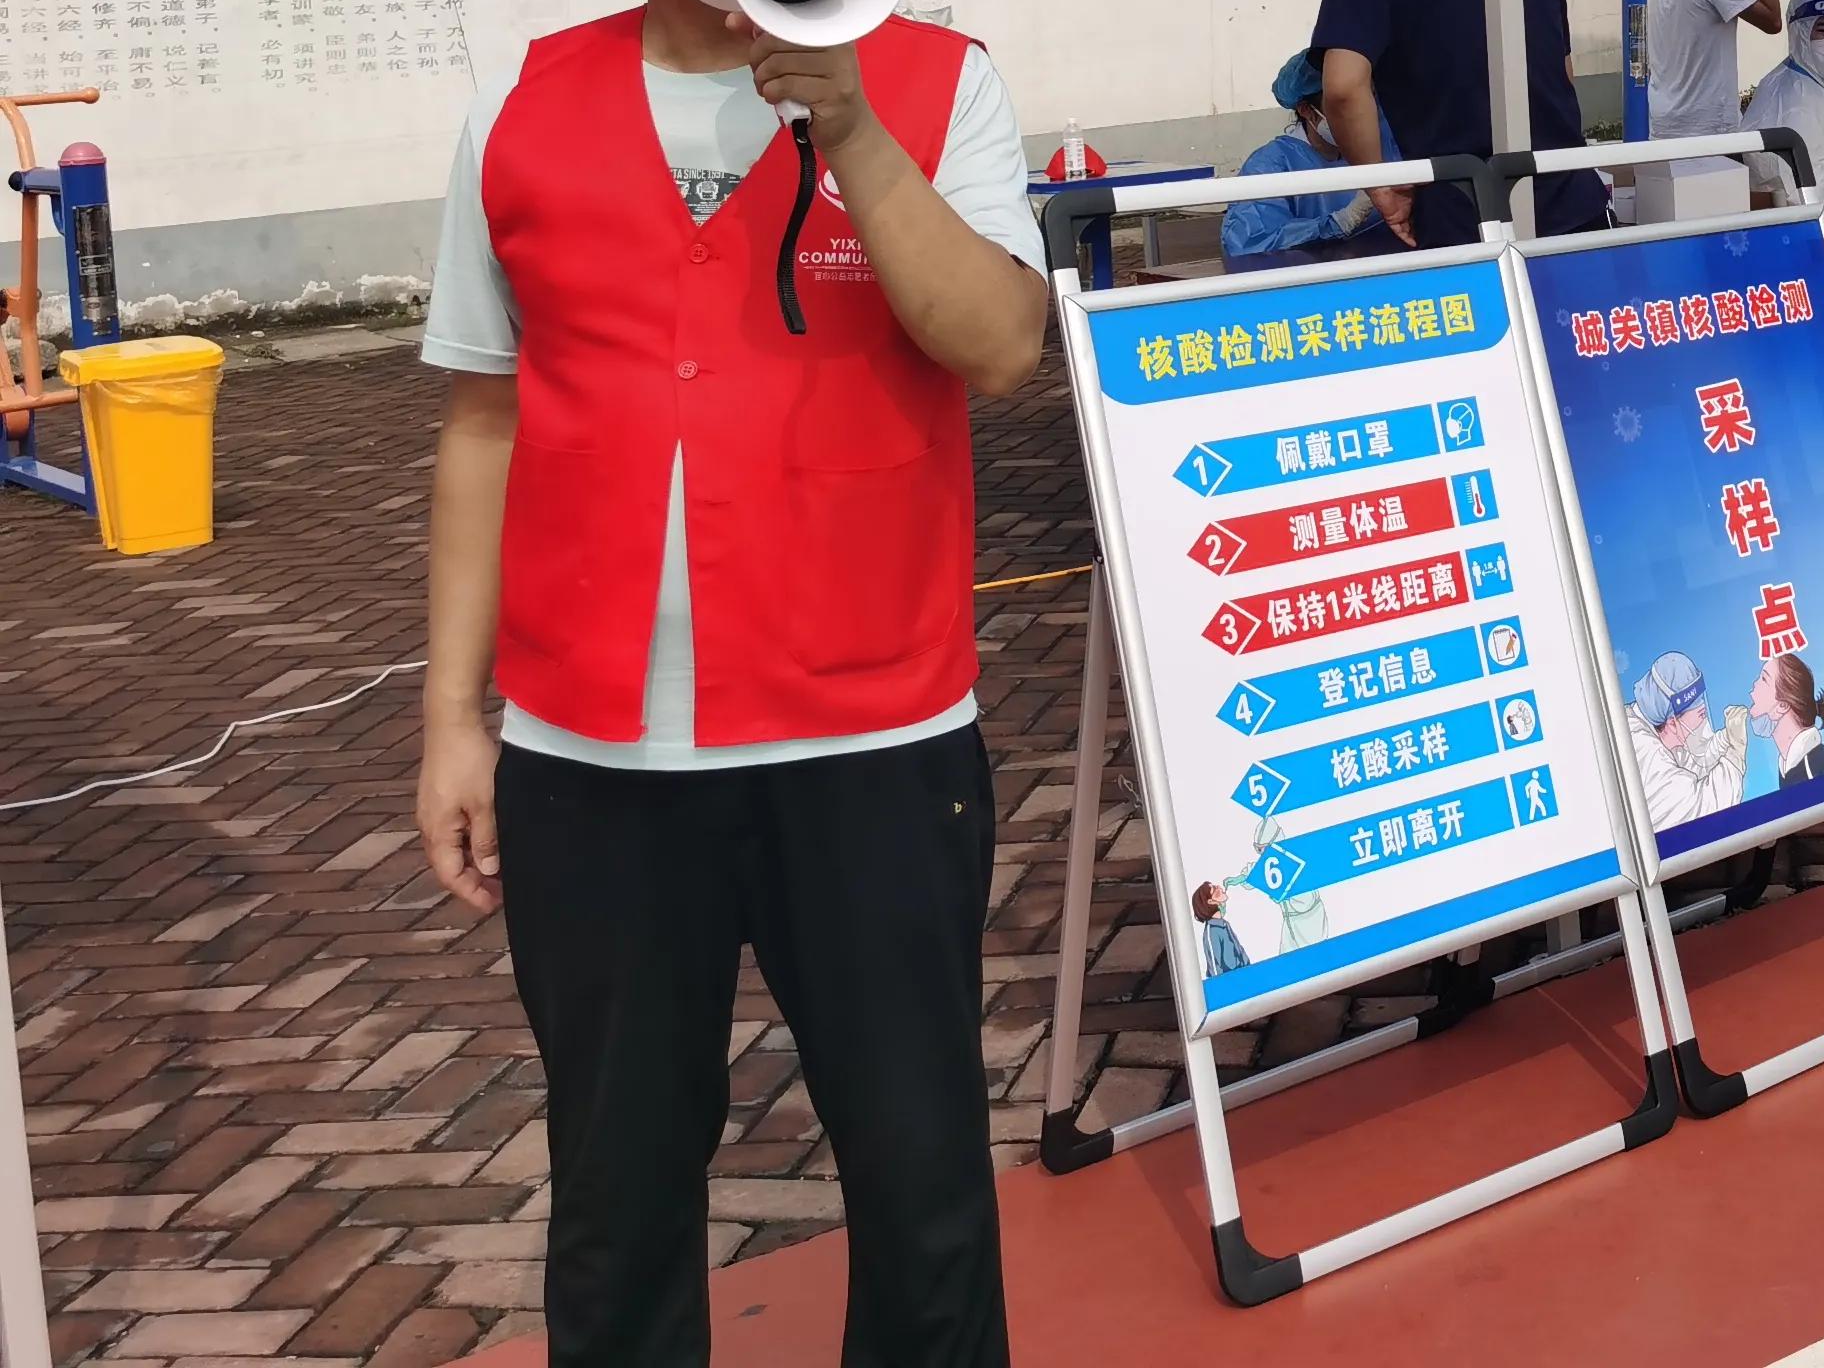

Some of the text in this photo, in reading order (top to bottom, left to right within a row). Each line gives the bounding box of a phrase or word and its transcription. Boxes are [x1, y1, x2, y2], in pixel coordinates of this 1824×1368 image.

[683, 168, 706, 180] SINCE
[1136, 292, 1476, 383] 核酸检测采样流程图
[1572, 279, 1813, 357] 城关镇核酸检测
[1193, 420, 1396, 486] 1 佩戴口罩
[1204, 496, 1409, 566] 2 测量体温
[1695, 376, 1808, 661] 采样点
[1219, 560, 1459, 646] 3 保持1米线距离
[1233, 645, 1438, 727] 4 登记信息
[1247, 721, 1451, 808] 5 核酸采样
[1262, 797, 1466, 887] 6 立即离开
